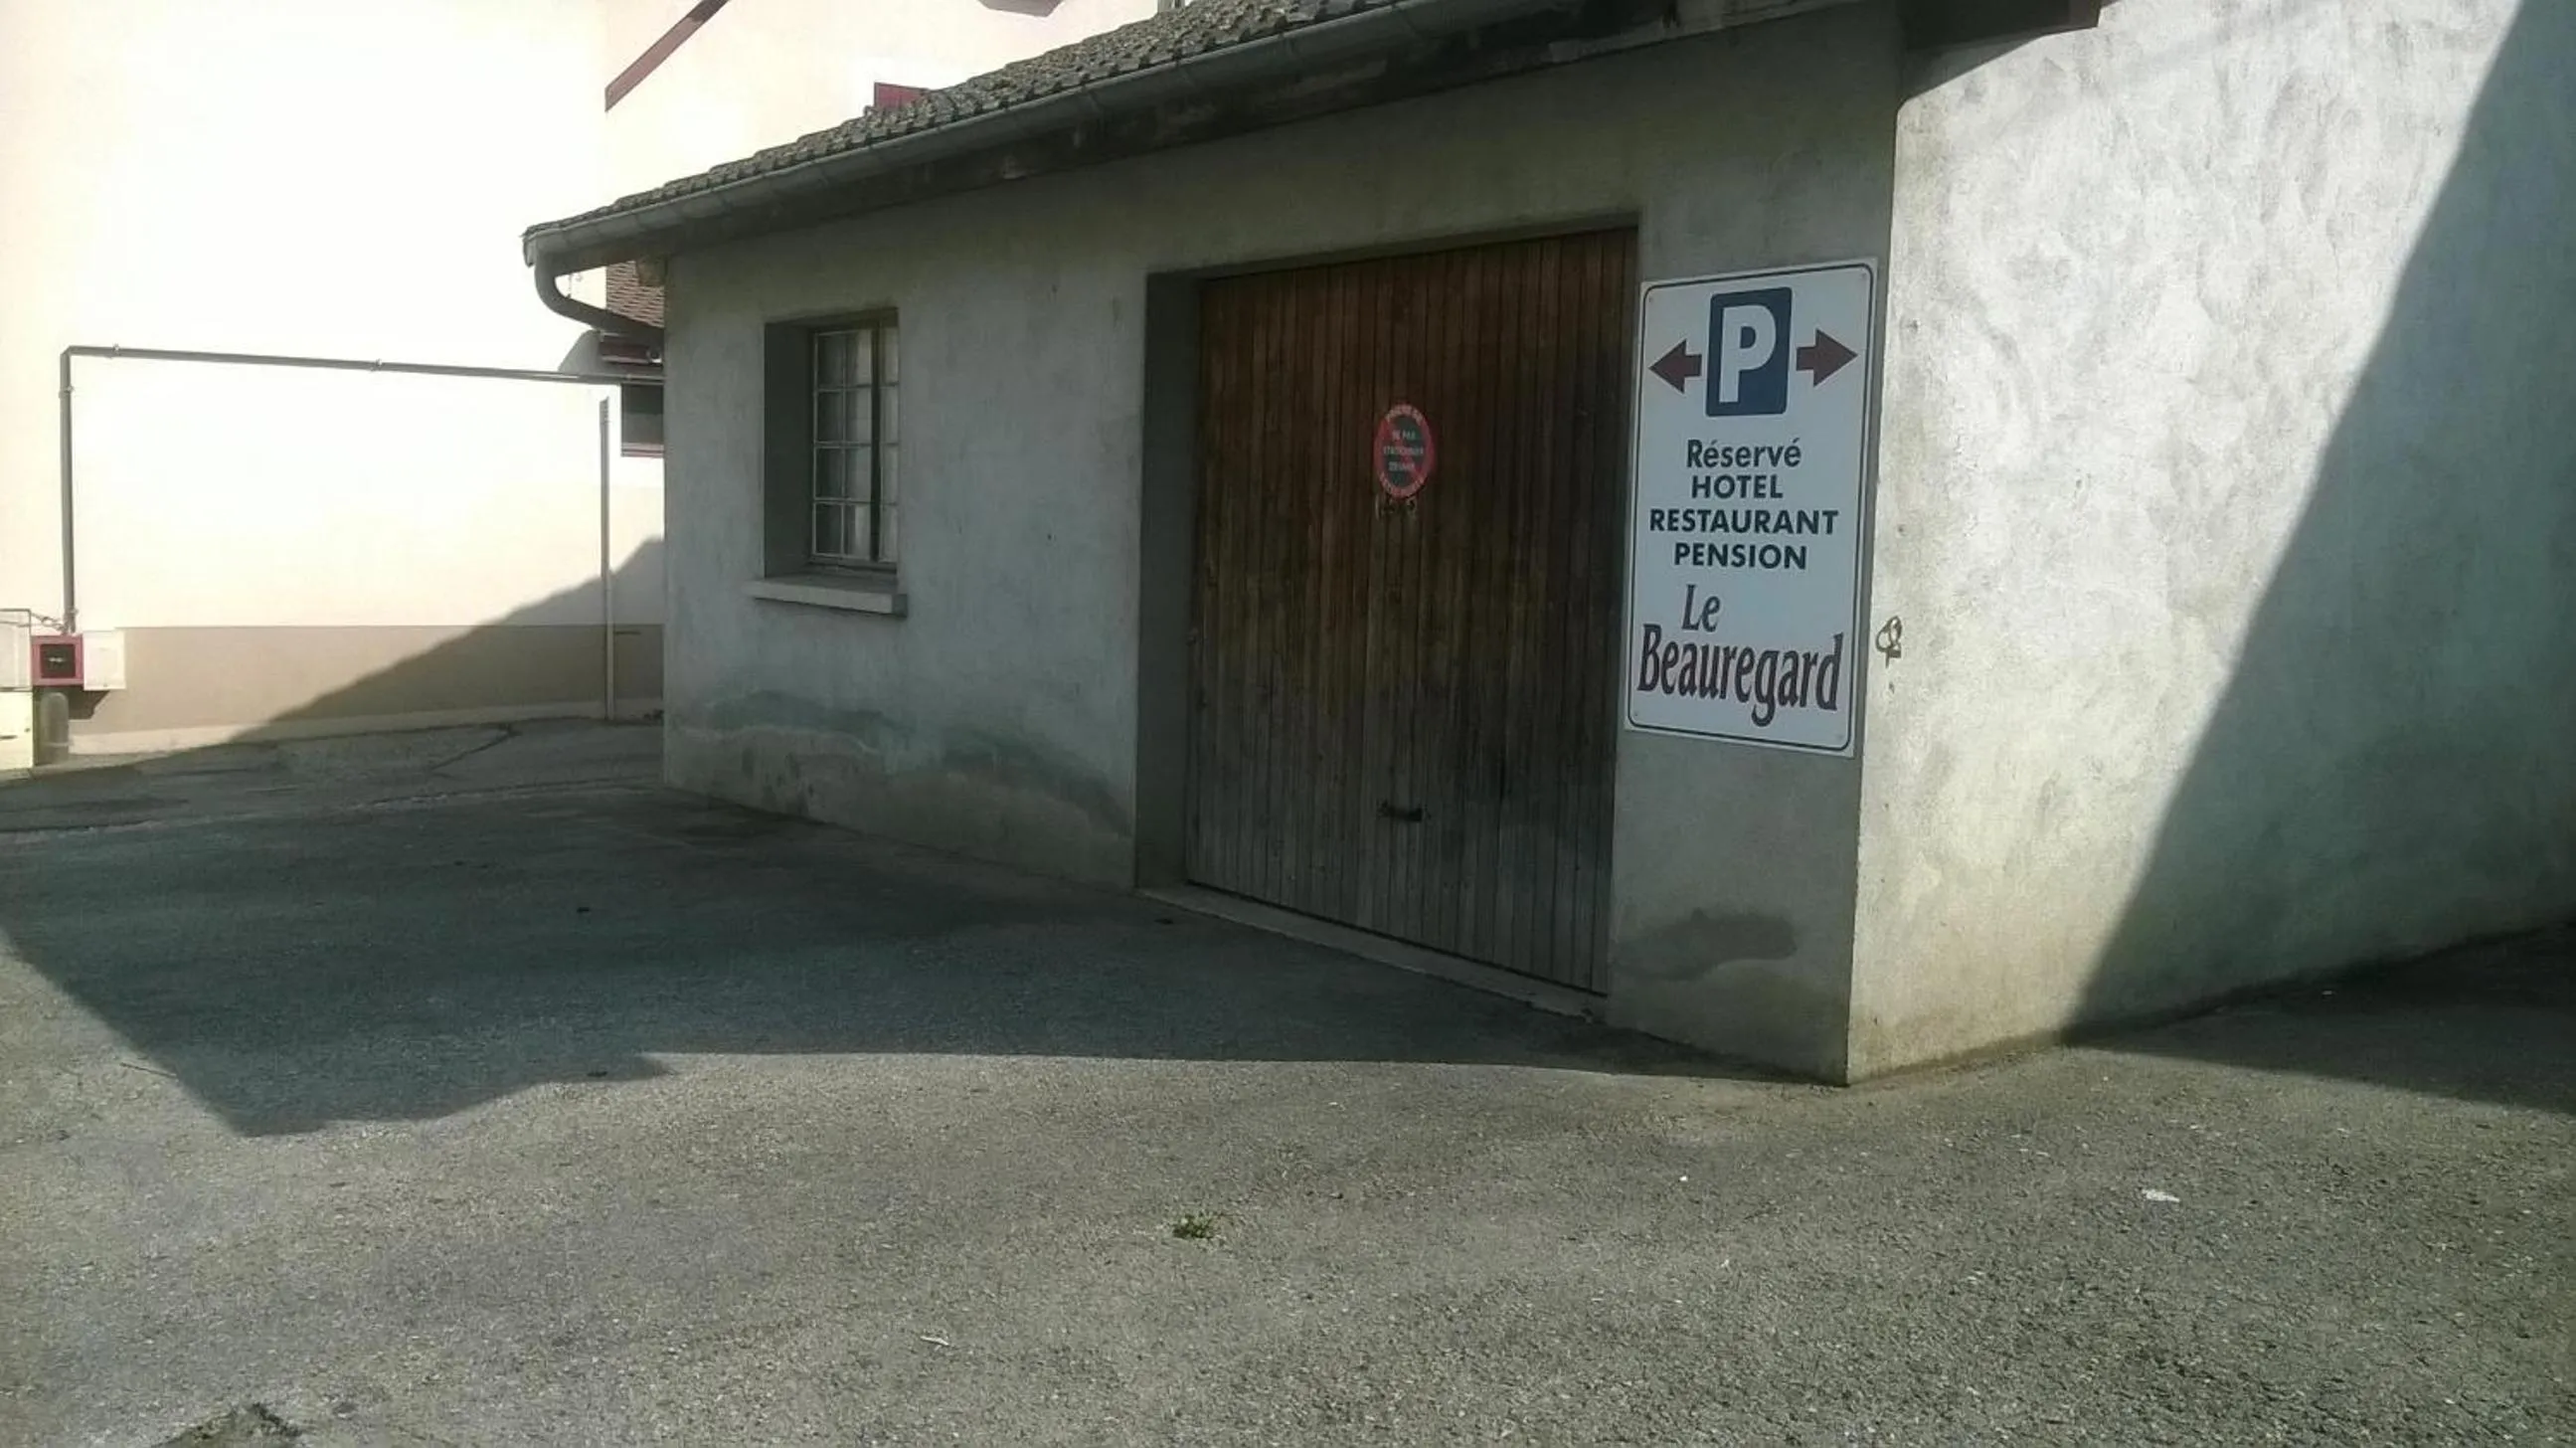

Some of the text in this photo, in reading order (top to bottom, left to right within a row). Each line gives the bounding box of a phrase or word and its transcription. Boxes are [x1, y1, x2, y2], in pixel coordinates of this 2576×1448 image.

[1718, 303, 1778, 403] P
[1686, 438, 1802, 468] Réservé
[1690, 474, 1784, 499] HOTEL
[1649, 509, 1839, 535] RESTAURANT
[1674, 543, 1807, 570] PENSION
[1681, 584, 1721, 633] Le
[1637, 624, 1844, 727] Beauregard
